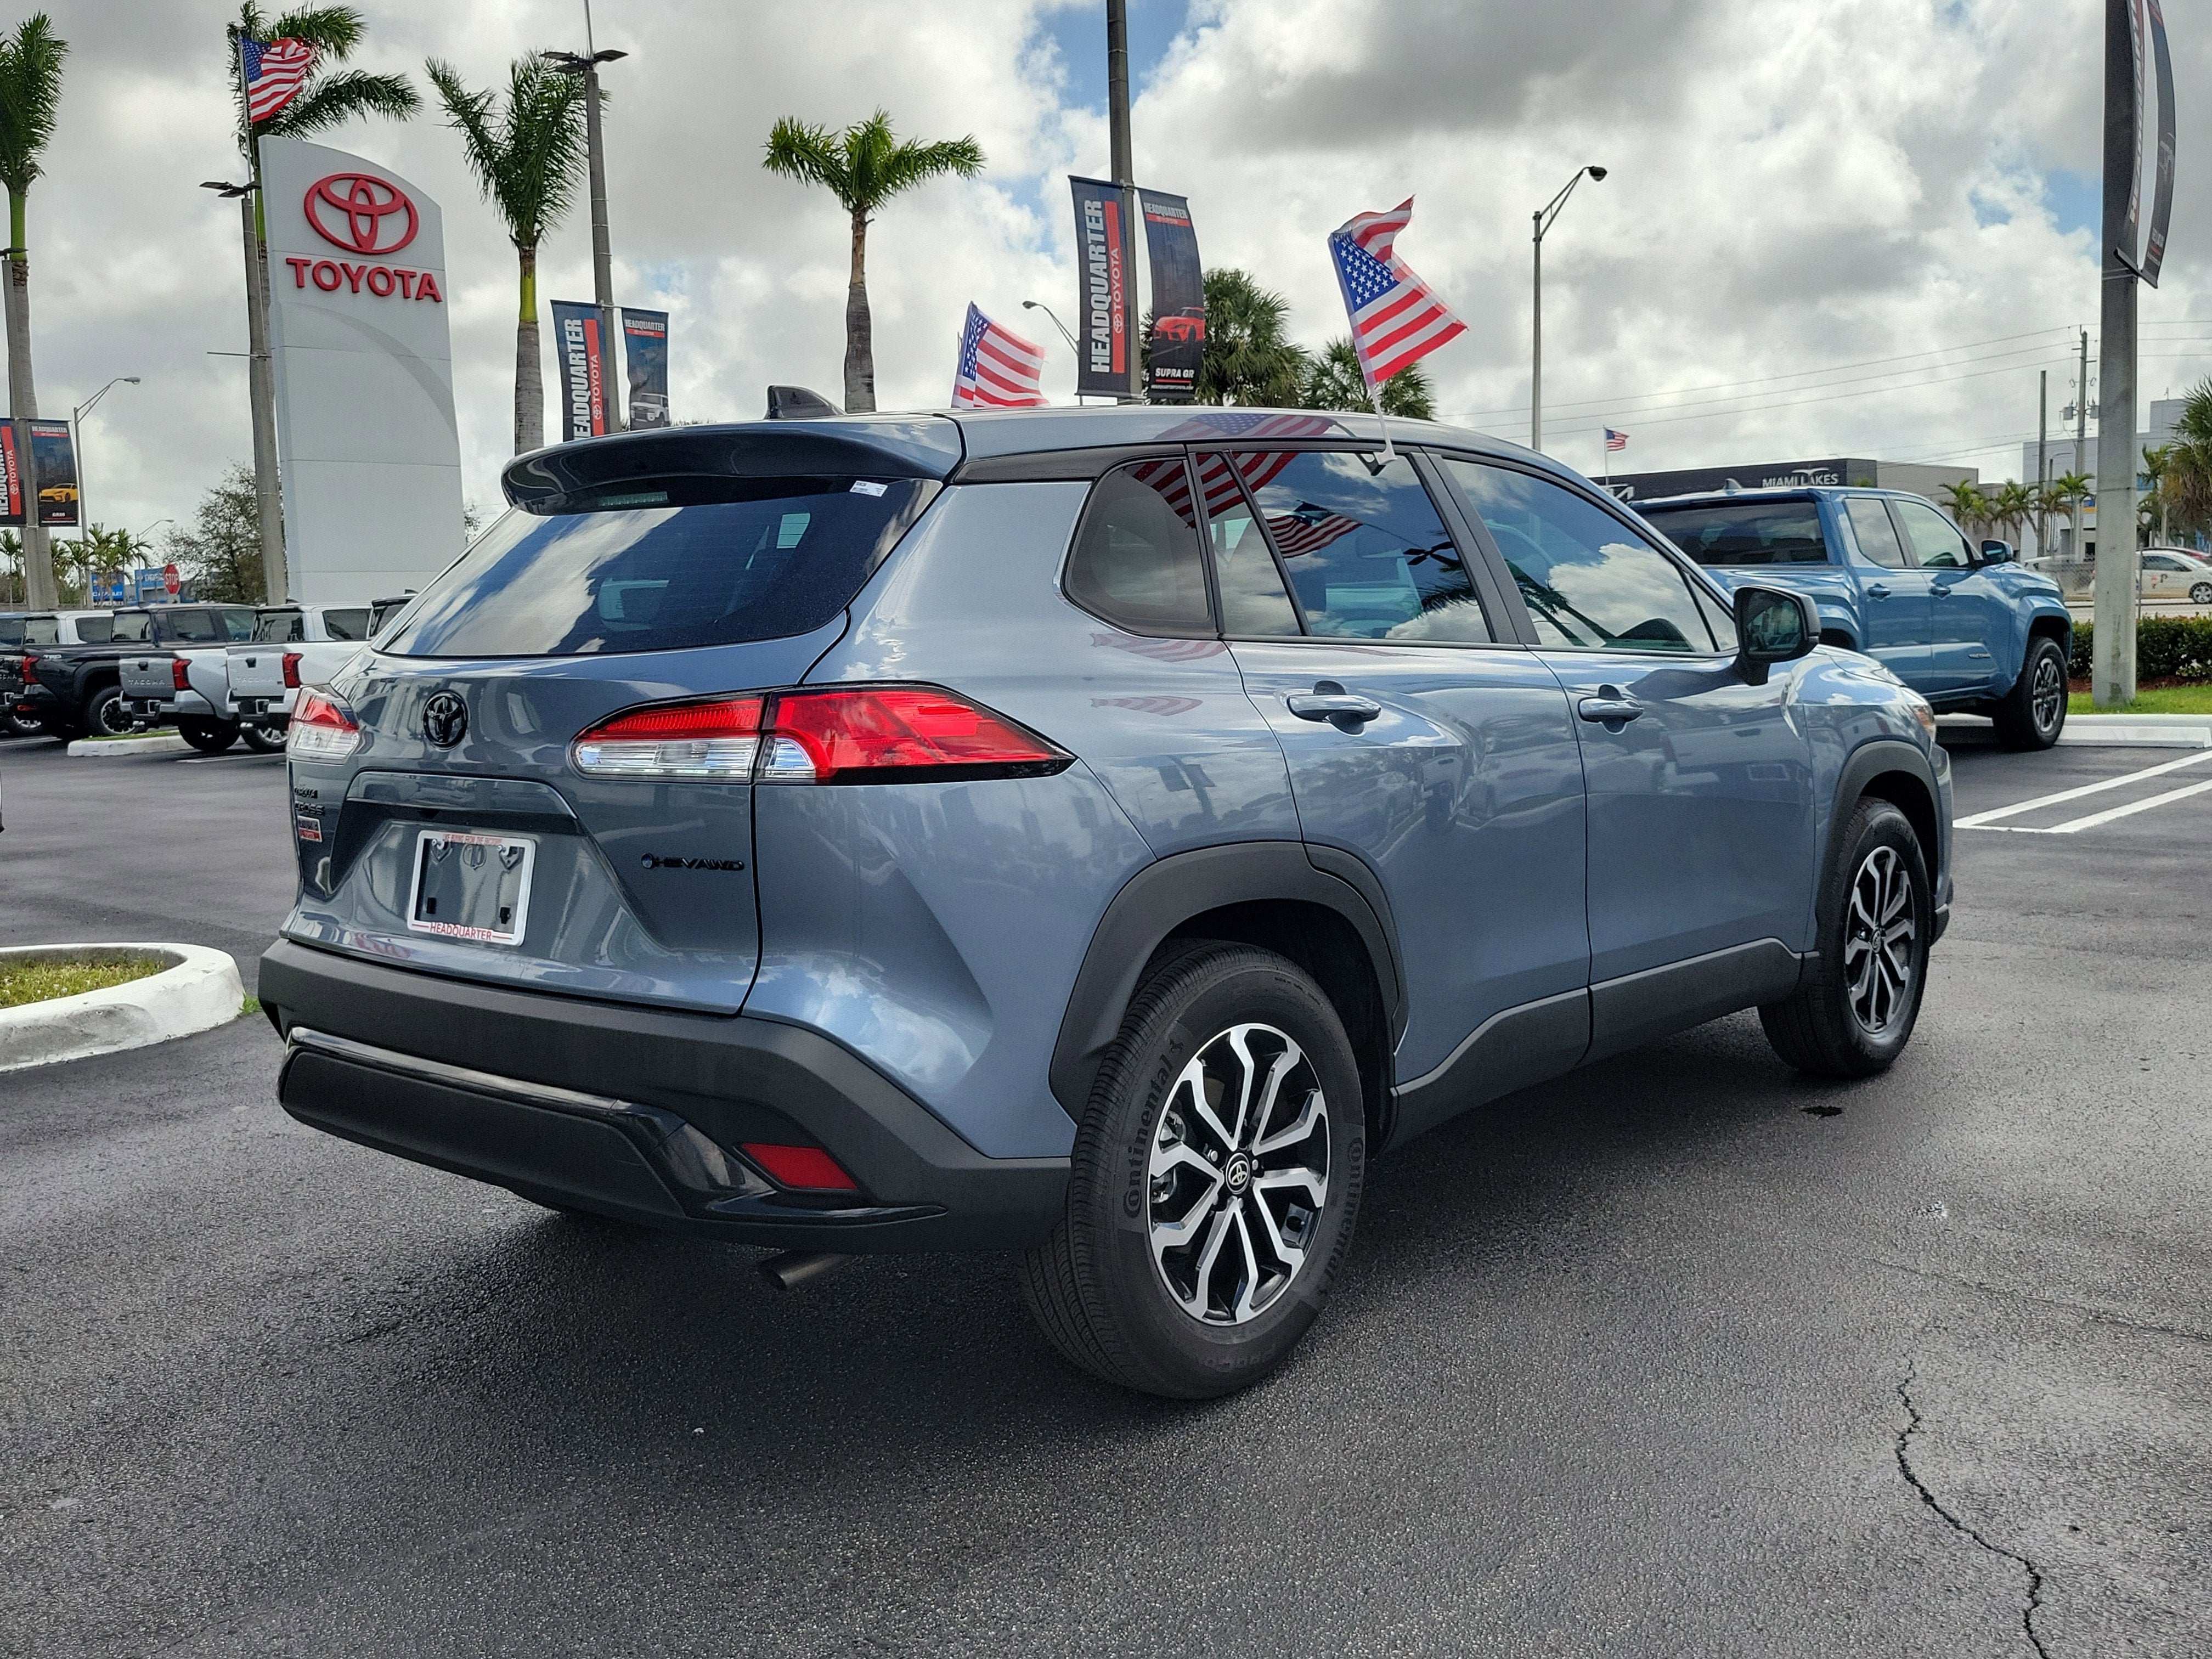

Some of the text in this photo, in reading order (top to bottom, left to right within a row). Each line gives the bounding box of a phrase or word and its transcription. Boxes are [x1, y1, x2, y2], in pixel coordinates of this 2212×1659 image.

[286, 257, 443, 302] TOYOTA
[1084, 200, 1111, 373] HEADQUARTER
[1110, 248, 1122, 312] TOYOTA
[624, 319, 665, 331] HEADQUARTER
[590, 354, 602, 404] TOYOTA
[1155, 367, 1194, 378] SUPRA GR
[7, 450, 18, 483] TOYOTA
[1762, 473, 1838, 488] MIAMI LAKES
[165, 573, 179, 585] STOP
[430, 922, 493, 941] HEADQUARTER
[1124, 1053, 1173, 1218] Continental
